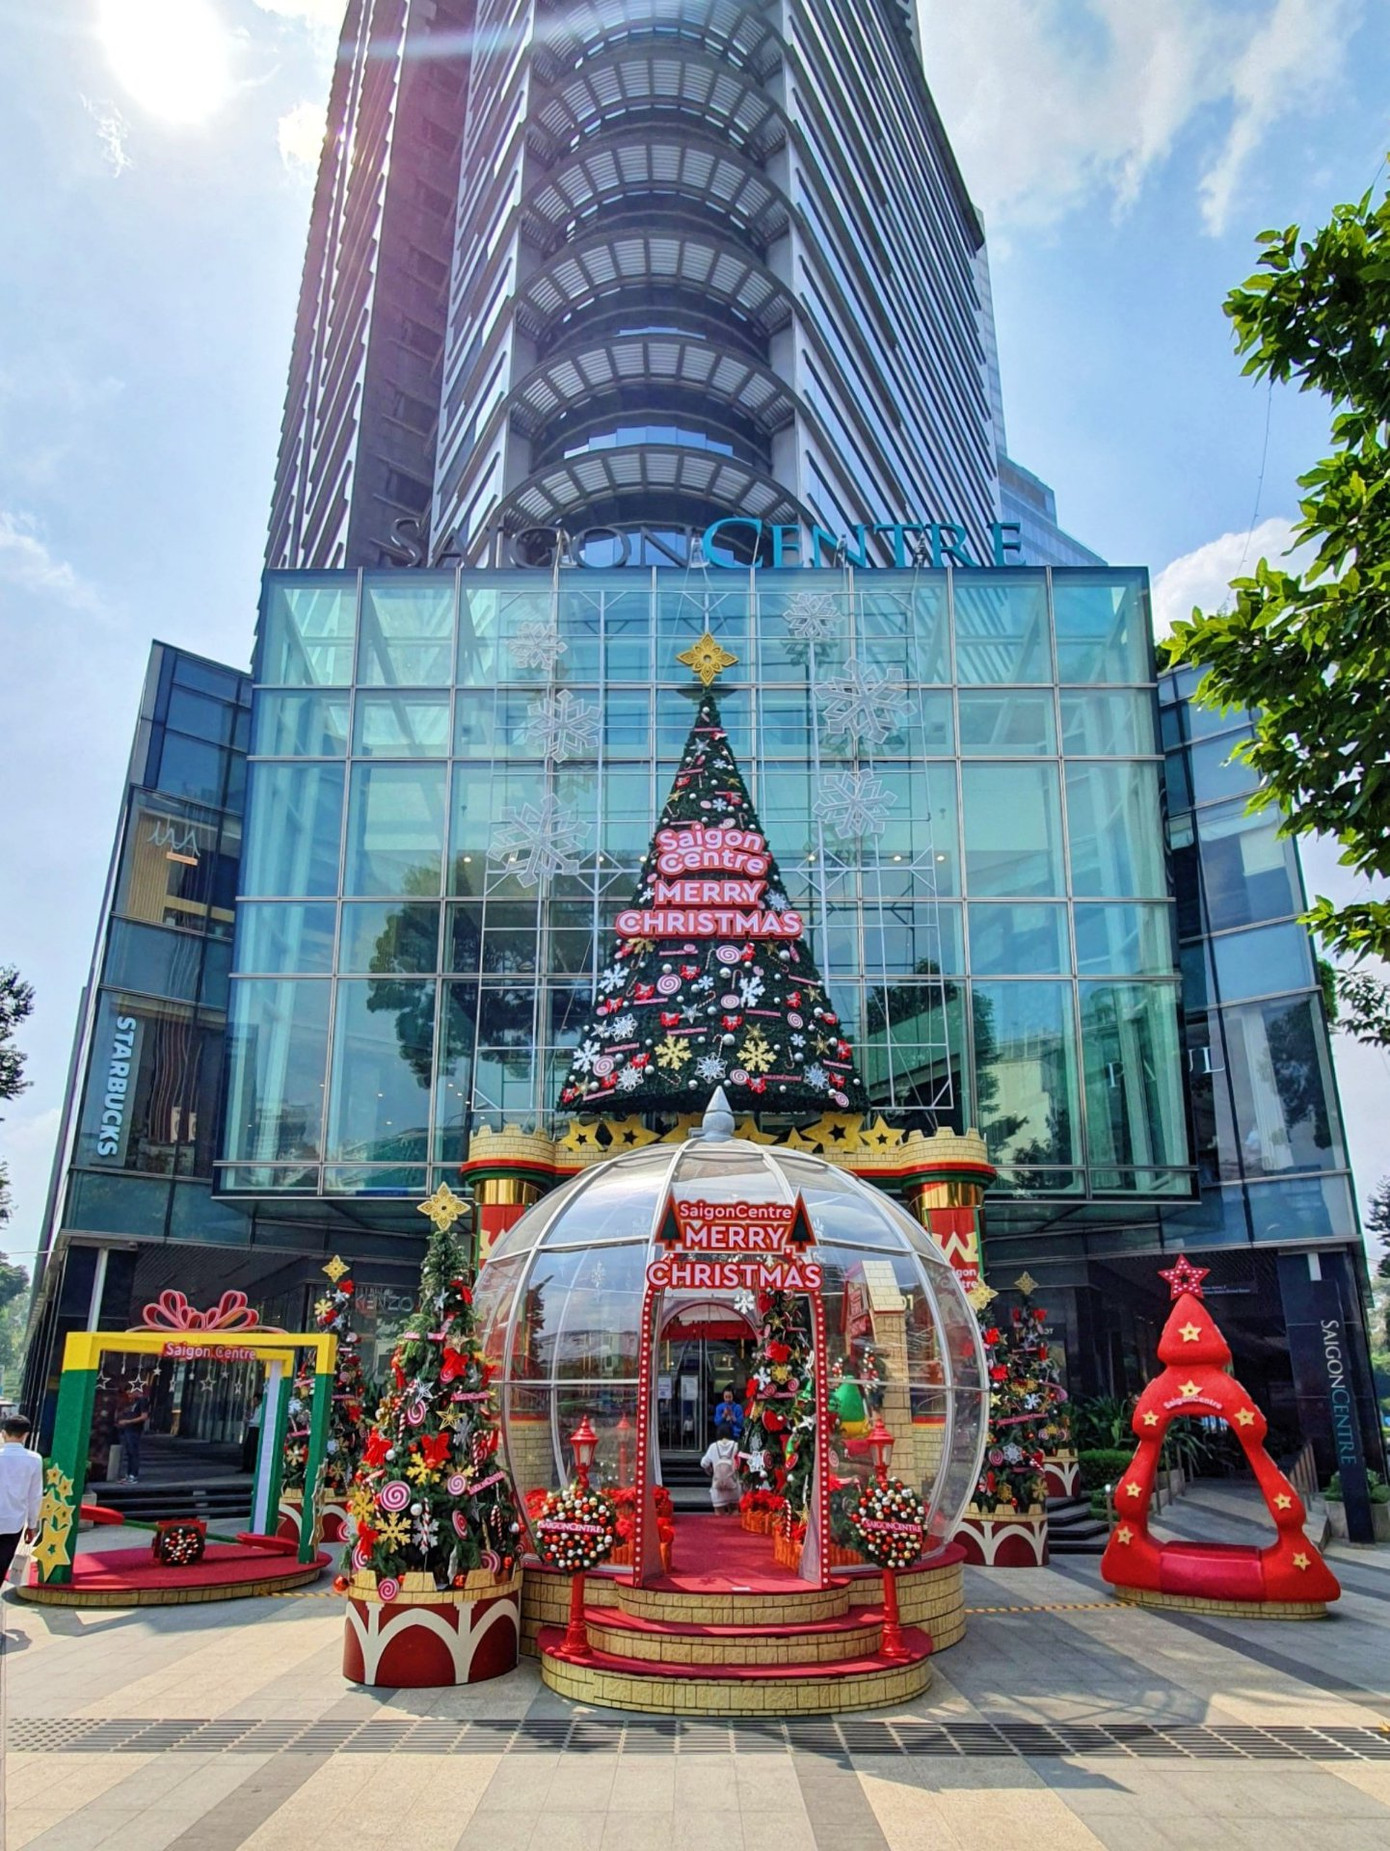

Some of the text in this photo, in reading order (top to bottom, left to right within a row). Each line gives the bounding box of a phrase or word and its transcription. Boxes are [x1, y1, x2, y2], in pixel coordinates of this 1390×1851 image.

[659, 823, 764, 851] Saigon
[659, 851, 765, 874] Centre
[657, 882, 764, 903] MERRY
[618, 912, 801, 933] CHRISTMAS
[97, 1015, 136, 1157] STARBUCKS
[680, 1203, 792, 1221] SaigonCentre
[686, 1226, 785, 1248] MERRY
[649, 1262, 822, 1289] CHRISTMAS
[166, 1342, 256, 1360] Saigon Centre
